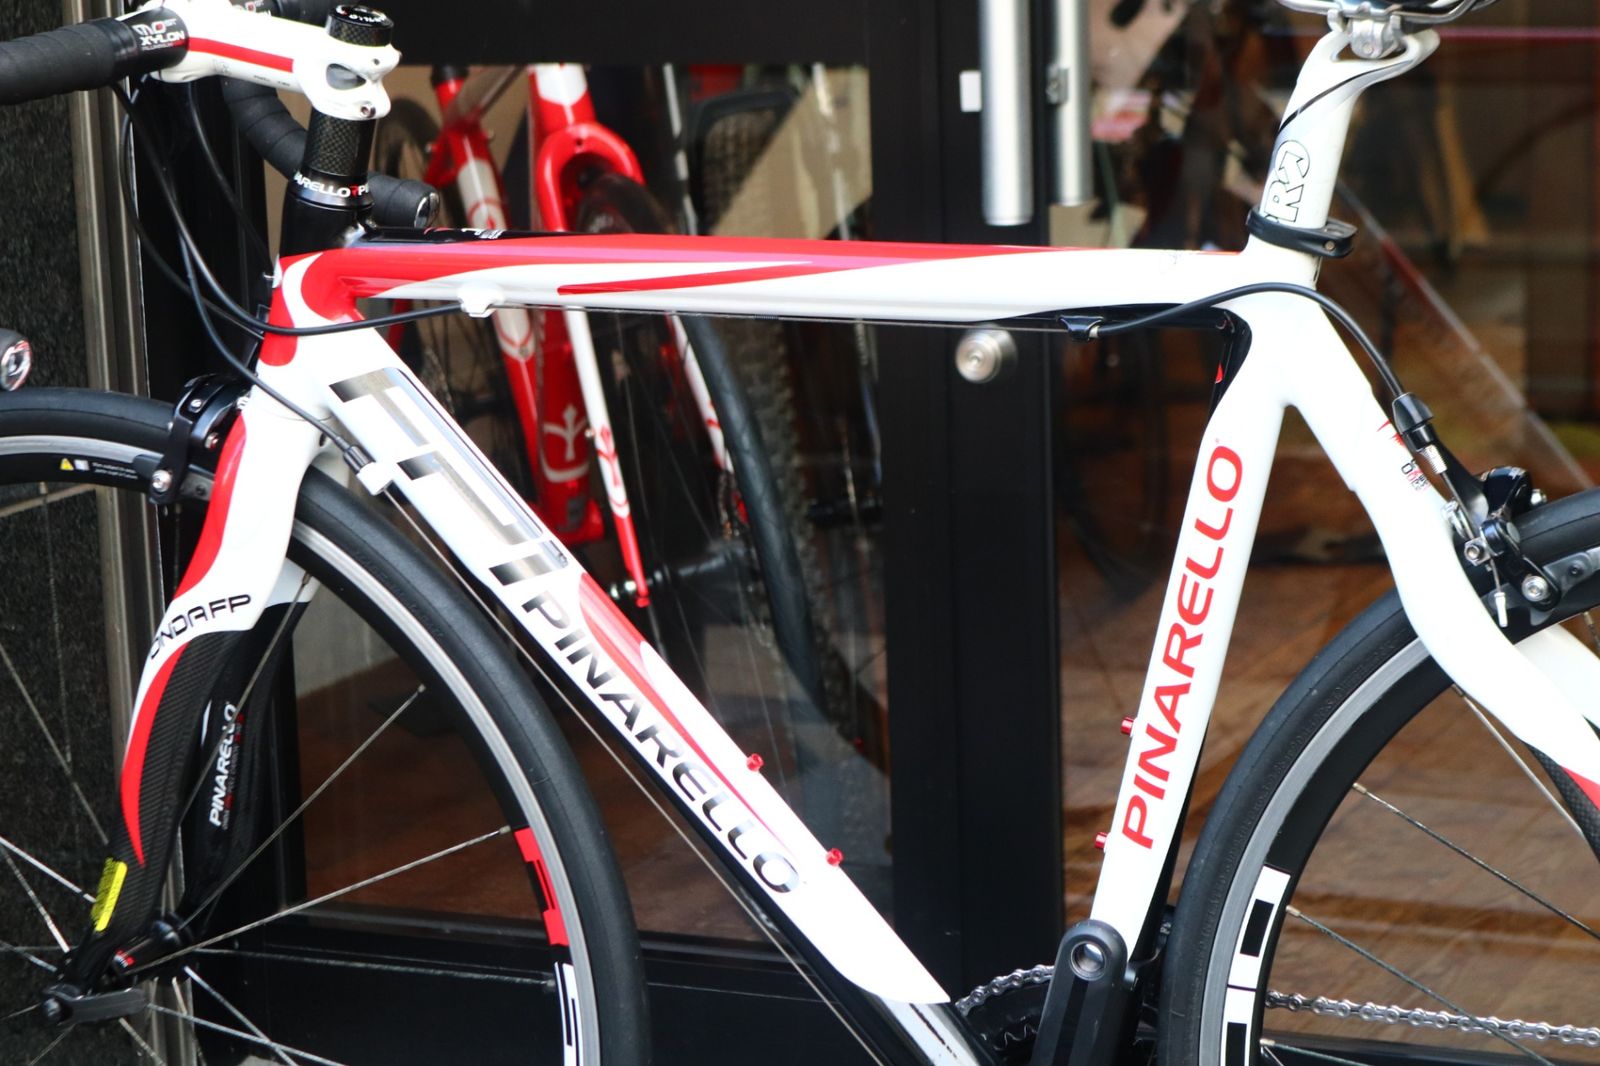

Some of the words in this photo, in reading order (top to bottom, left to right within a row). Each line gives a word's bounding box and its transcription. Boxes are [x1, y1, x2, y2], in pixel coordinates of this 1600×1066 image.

[139, 30, 186, 46] XYLON
[521, 590, 800, 894] PINARELLO
[1121, 445, 1243, 850] PINARELLO
